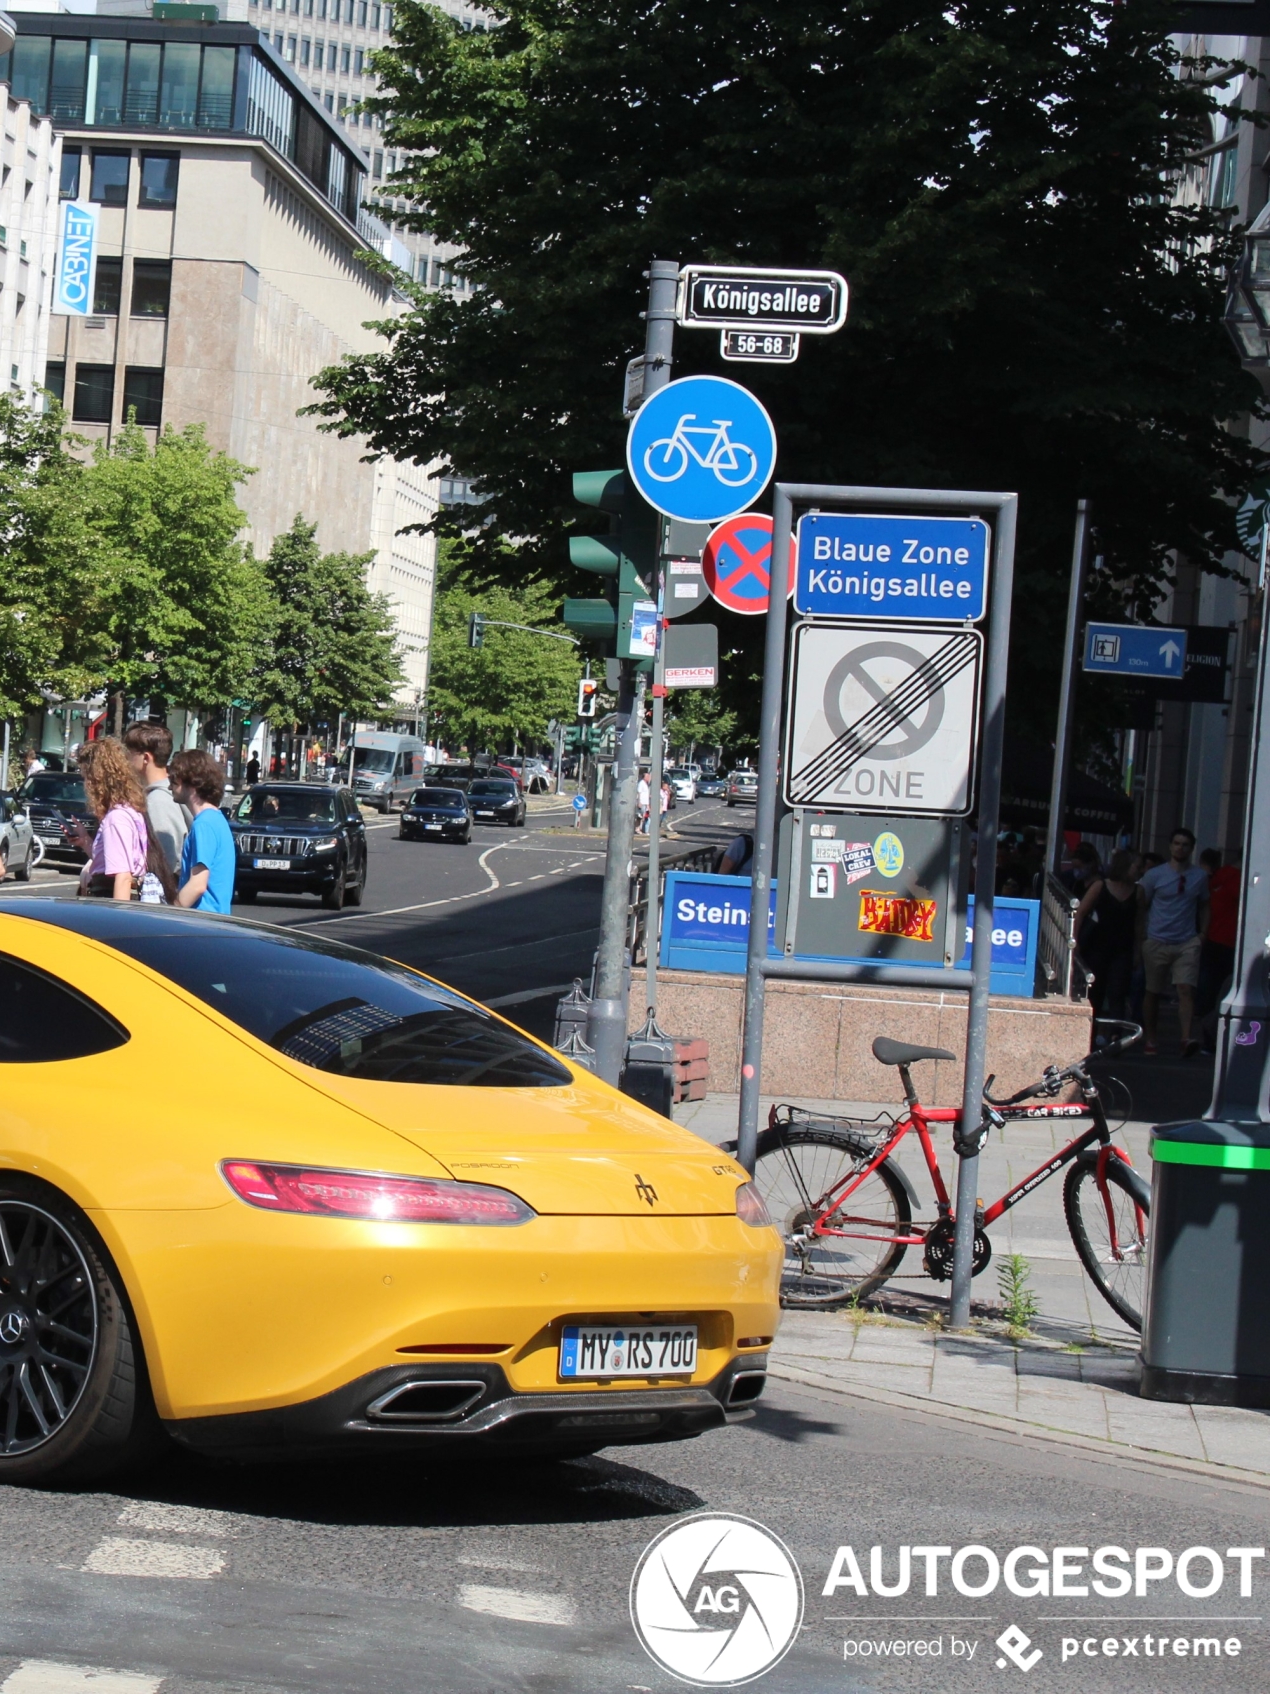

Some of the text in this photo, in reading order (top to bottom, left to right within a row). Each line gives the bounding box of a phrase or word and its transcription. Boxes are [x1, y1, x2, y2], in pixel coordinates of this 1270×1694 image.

[62, 212, 91, 303] CABINET
[703, 284, 821, 316] Königsallee
[737, 337, 783, 354] 56-68
[813, 537, 970, 566] Blaue Zone
[808, 569, 972, 602] Königsallee
[1128, 658, 1149, 667] 130m
[1186, 653, 1222, 668] ELIGION
[666, 669, 713, 677] GERKEN
[833, 768, 925, 800] ZONE
[1073, 807, 1117, 821] COFFEE
[844, 848, 871, 861] LOKAL
[848, 859, 871, 871] CREW
[1027, 1107, 1048, 1117] CAR
[1008, 1189, 1024, 1203] SUPER
[1024, 1168, 1051, 1190] OVERSIZED
[580, 1331, 694, 1370] MY RS 700
